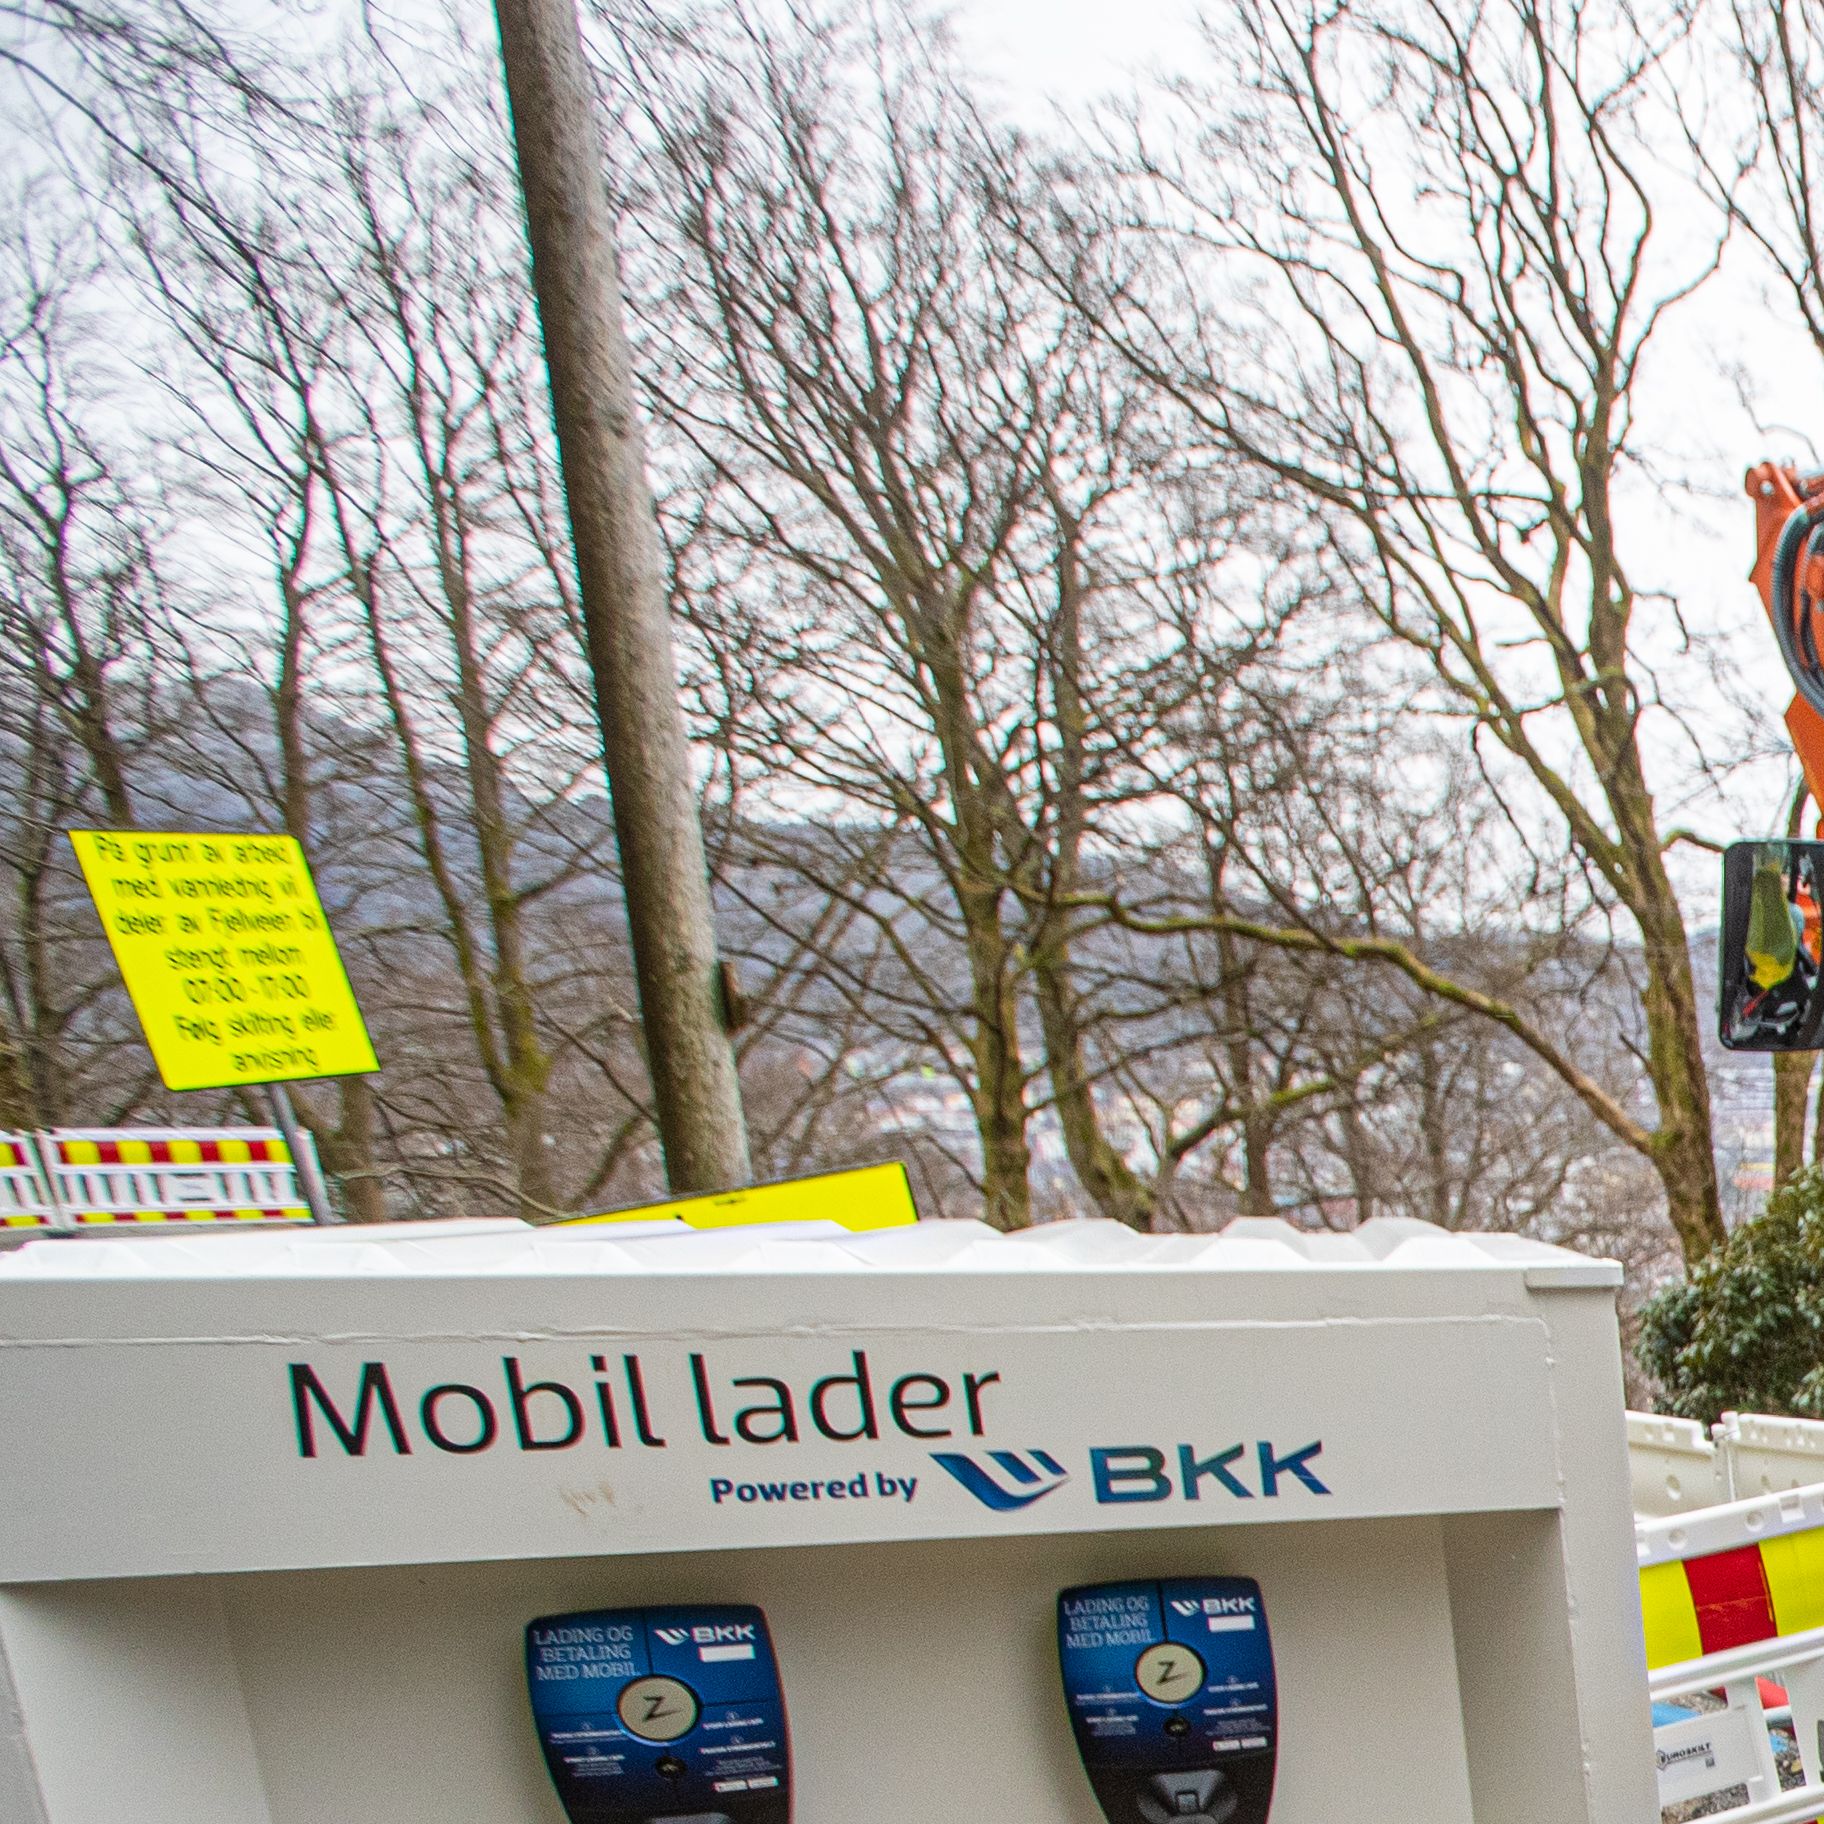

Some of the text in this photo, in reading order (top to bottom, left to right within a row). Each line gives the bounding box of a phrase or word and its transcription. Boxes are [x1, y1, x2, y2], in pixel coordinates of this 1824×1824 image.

[132, 841, 192, 869] grunn
[112, 872, 163, 900] med
[114, 906, 168, 936] deler
[164, 942, 308, 974] stengt mellom
[288, 1350, 1000, 1458] Mobil lader
[1089, 1440, 1332, 1504] BKK
[709, 1473, 918, 1504] Powered by
[1064, 1596, 1149, 1616] LADING OG
[1202, 1597, 1255, 1614] BKK
[1070, 1613, 1148, 1632] BETALING
[533, 1624, 634, 1645] LADING OG
[692, 1624, 756, 1643] BKK
[1066, 1630, 1154, 1648] MED MOBIL
[541, 1643, 632, 1662] BETALING
[536, 1661, 640, 1681] MED MOBIL
